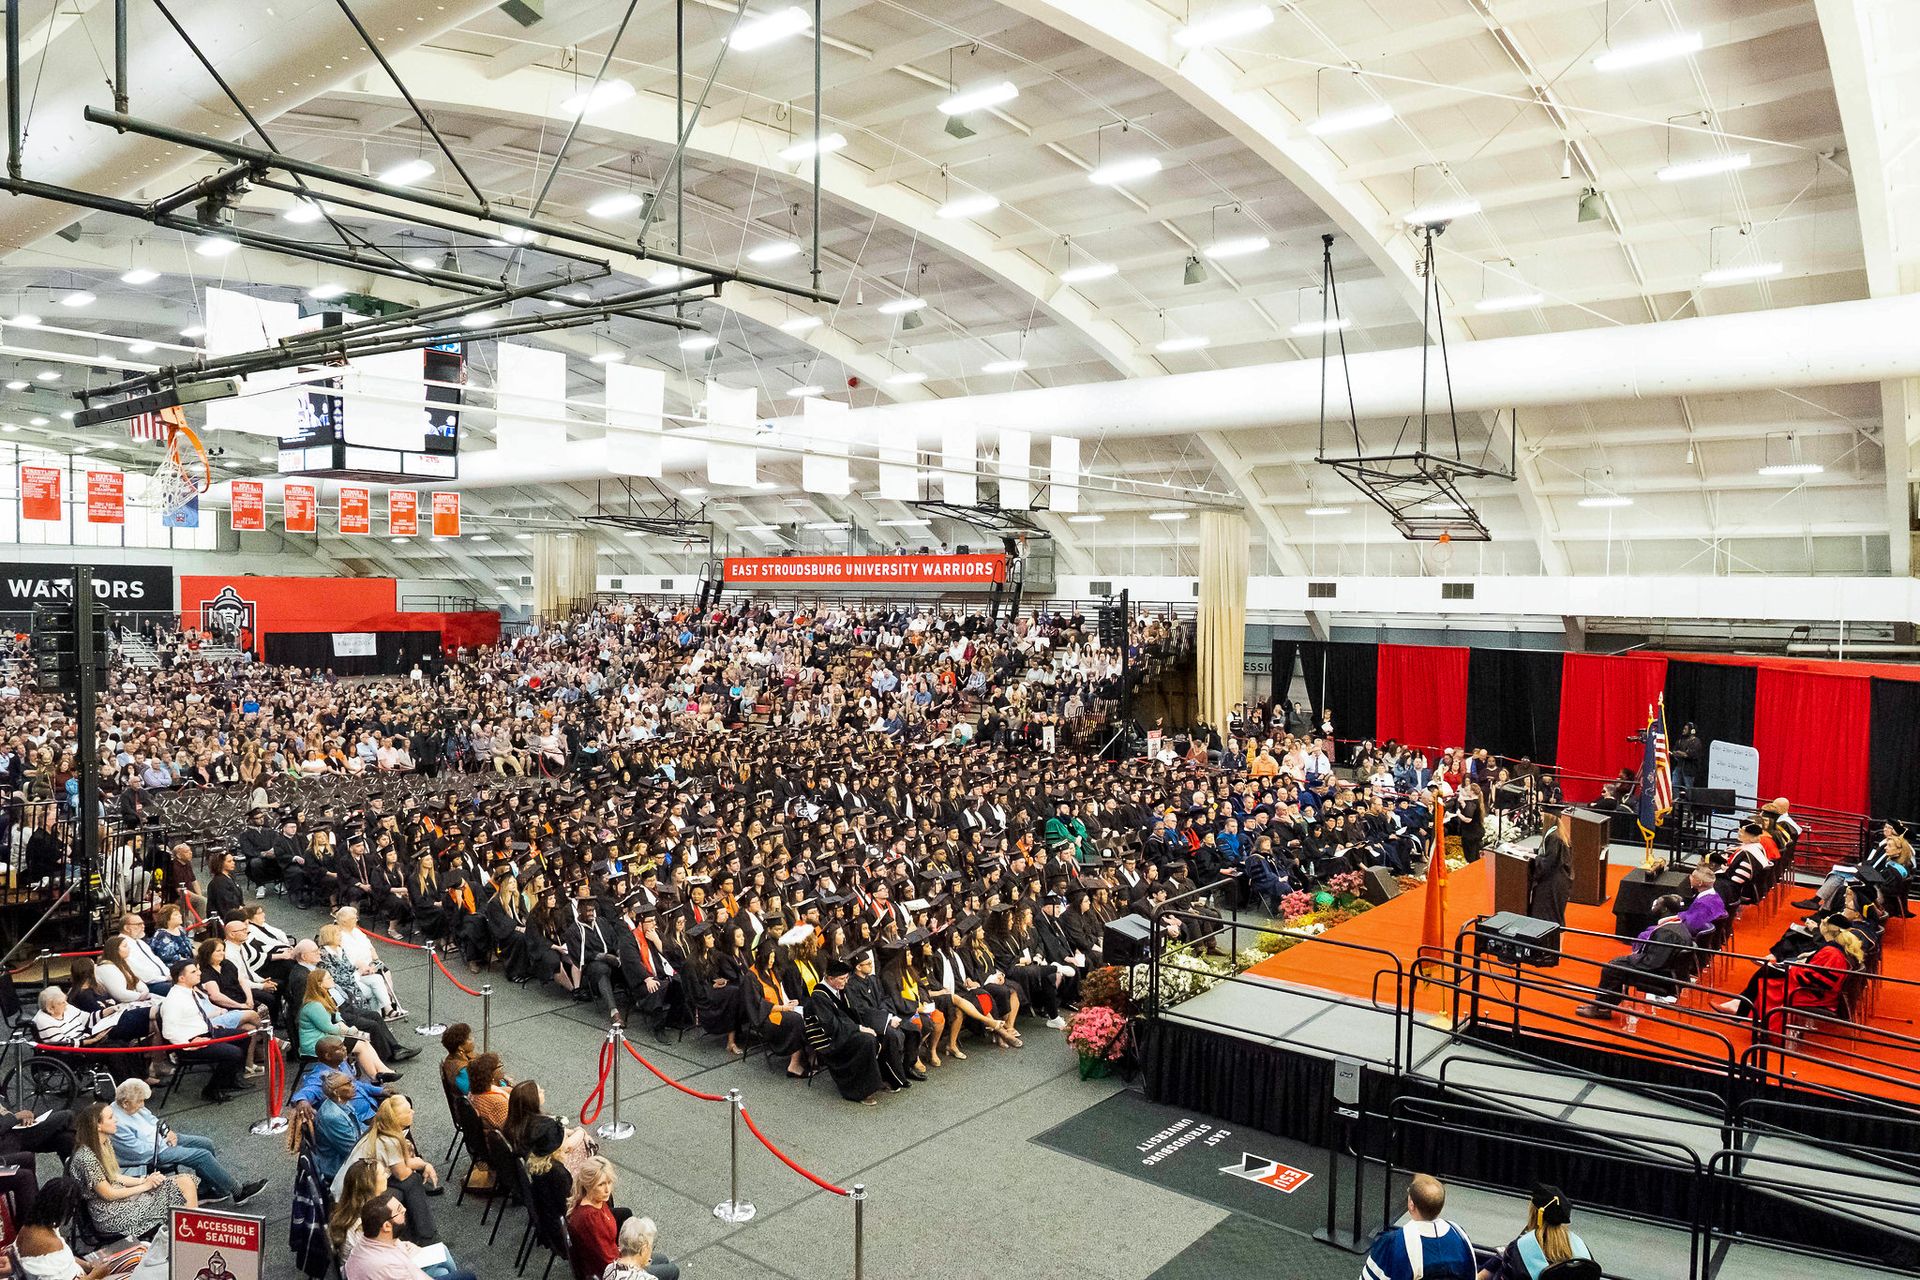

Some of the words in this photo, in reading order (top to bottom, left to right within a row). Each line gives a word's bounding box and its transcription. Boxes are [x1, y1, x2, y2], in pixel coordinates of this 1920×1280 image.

[731, 564, 758, 576] EAST
[761, 563, 842, 576] STROUDSBURG
[845, 562, 920, 576] UNIVERSITY
[922, 561, 993, 576] WARRIORS
[1136, 1118, 1194, 1153] UNIVERSITY
[1141, 1123, 1212, 1166] STROUDSBURG
[1204, 1128, 1232, 1147] EAST
[1273, 1169, 1302, 1188] ESU
[196, 1220, 254, 1236] ACCESSIBLE
[205, 1232, 246, 1245] SEATING
